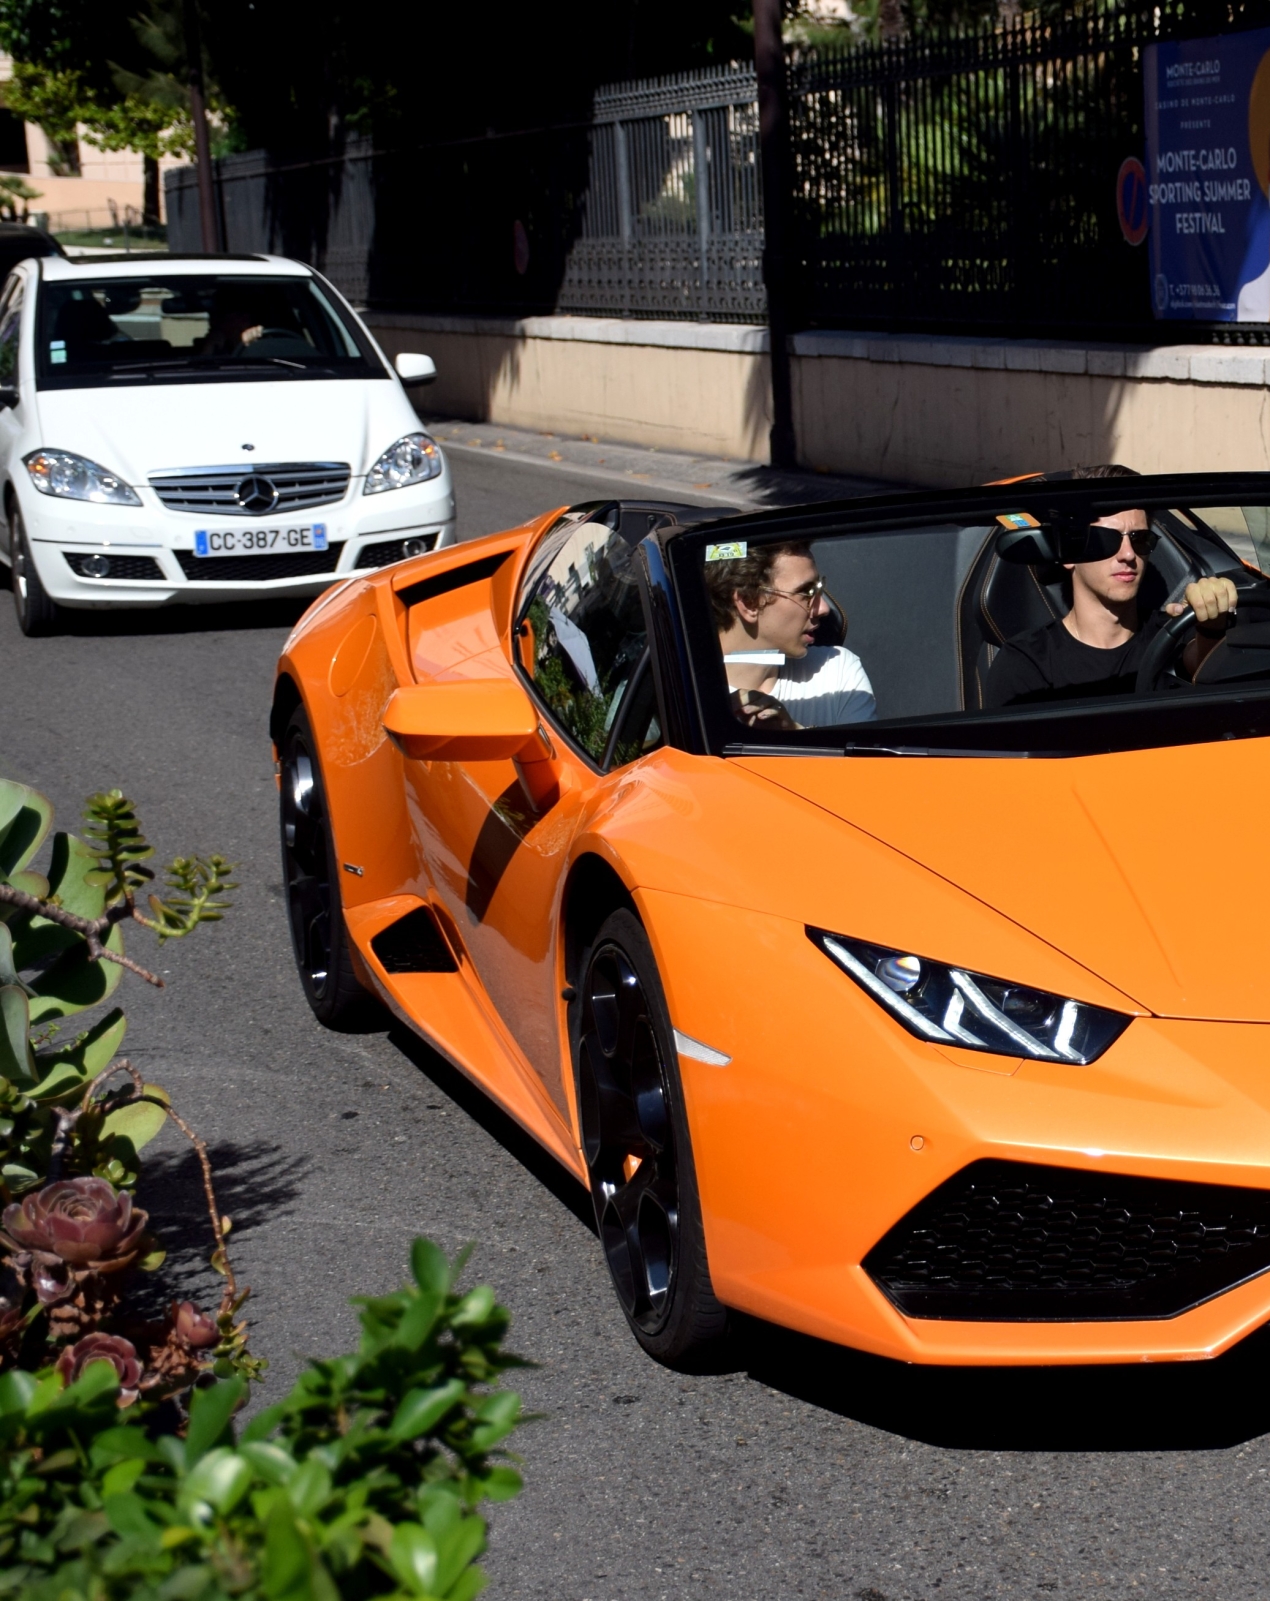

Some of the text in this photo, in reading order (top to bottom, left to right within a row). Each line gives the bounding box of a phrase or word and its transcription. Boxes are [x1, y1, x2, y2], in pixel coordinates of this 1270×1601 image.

[1156, 147, 1237, 173] MONTE-CARLO
[1148, 178, 1251, 205] SPORTING SUMMER
[1176, 212, 1226, 234] FESTIVAL
[210, 528, 312, 551] CC-387-GE
